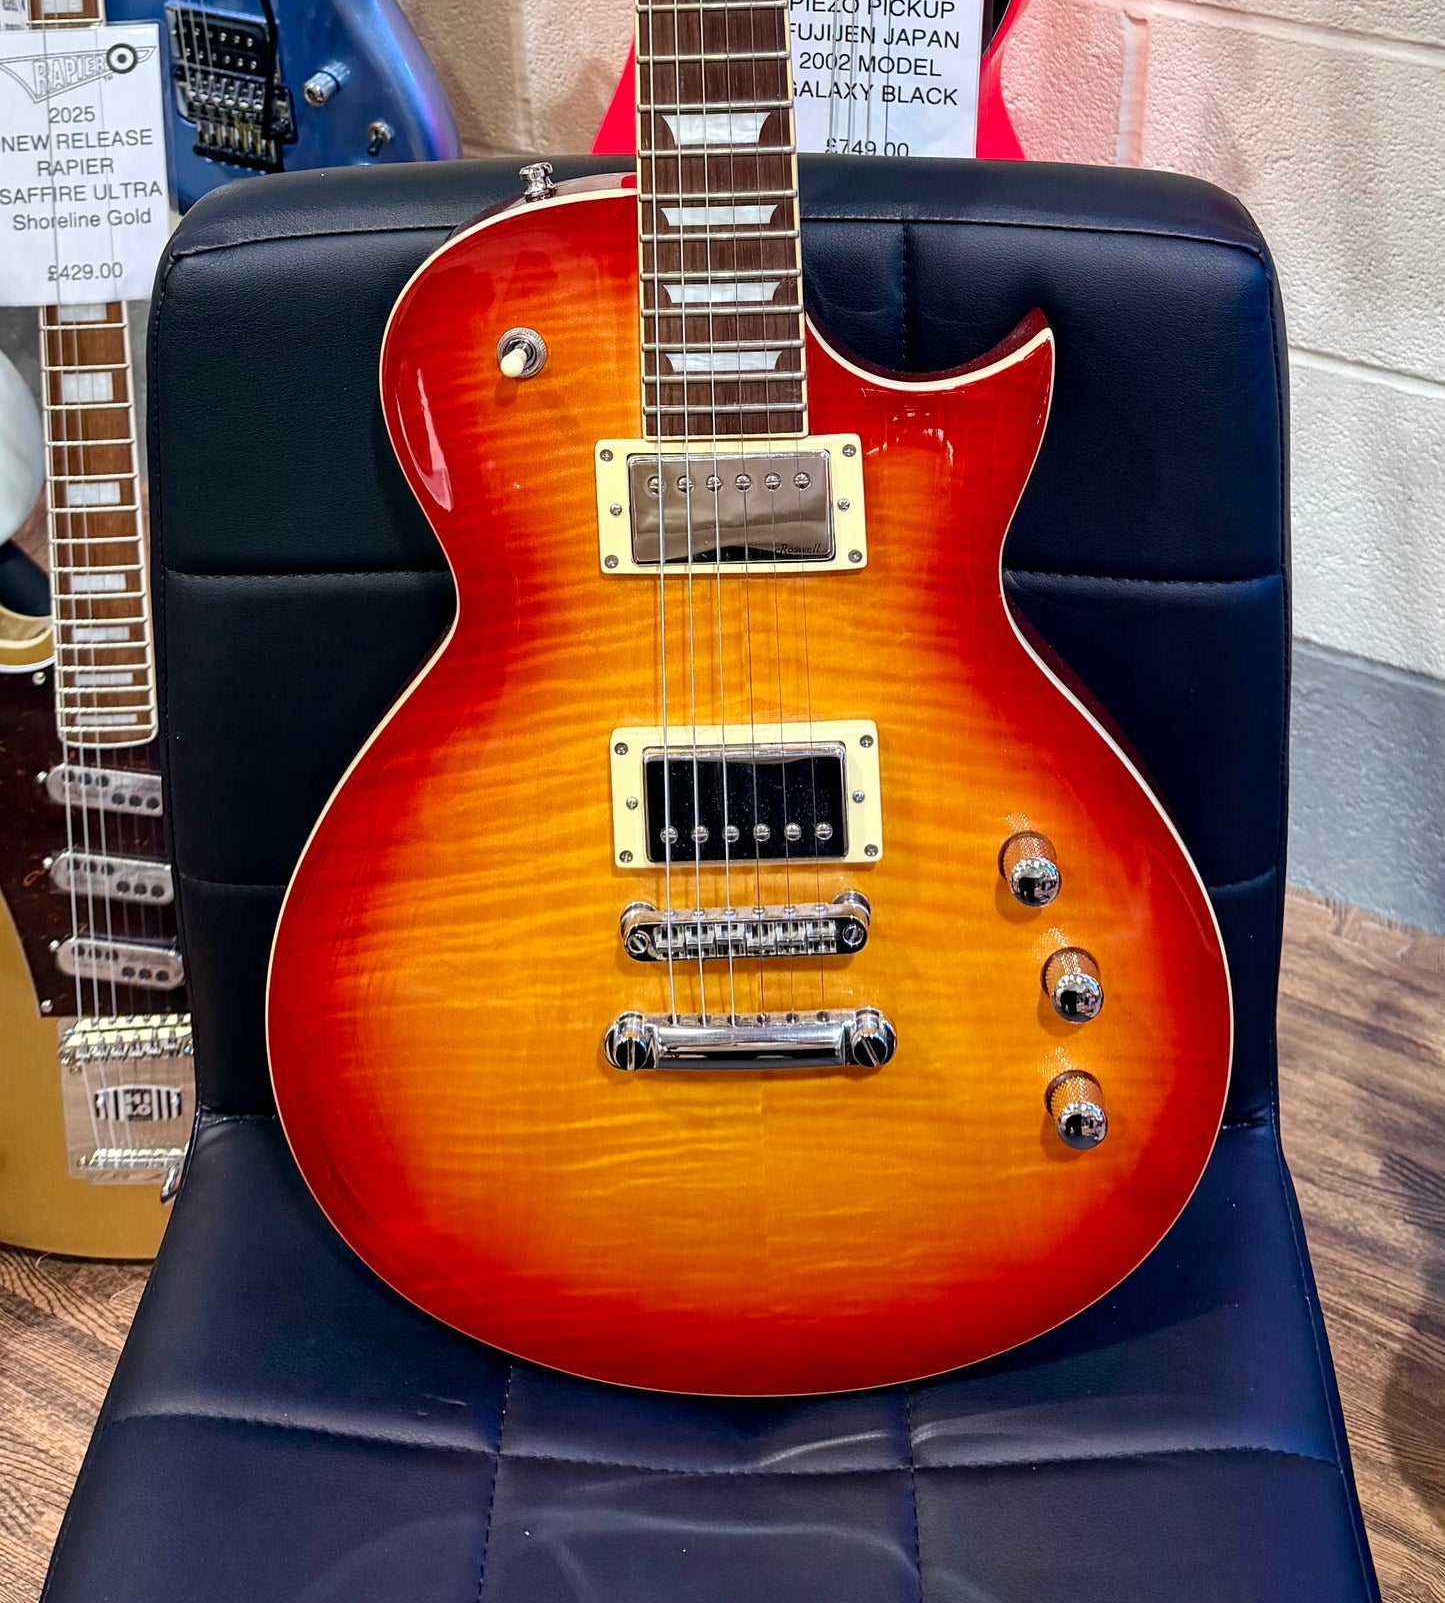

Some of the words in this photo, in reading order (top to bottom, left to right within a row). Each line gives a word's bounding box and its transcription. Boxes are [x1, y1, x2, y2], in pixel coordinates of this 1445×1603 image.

[883, 28, 960, 49] JAPAN
[33, 54, 109, 96] RAPIER
[799, 52, 851, 71] 2002
[858, 55, 942, 77] MODEL
[881, 85, 958, 106] BLACK
[48, 106, 96, 124] 2025
[2, 134, 50, 153] NEW
[57, 128, 153, 150] RELEASE
[825, 137, 909, 156] £74900
[37, 157, 114, 177] RAPIER
[0, 185, 87, 205] SAFFIRE
[94, 181, 163, 201] ULTRA
[13, 212, 101, 231] Shoreline
[107, 207, 152, 226] Gold
[47, 262, 123, 282] £429.00
[776, 543, 820, 555] Roswell
